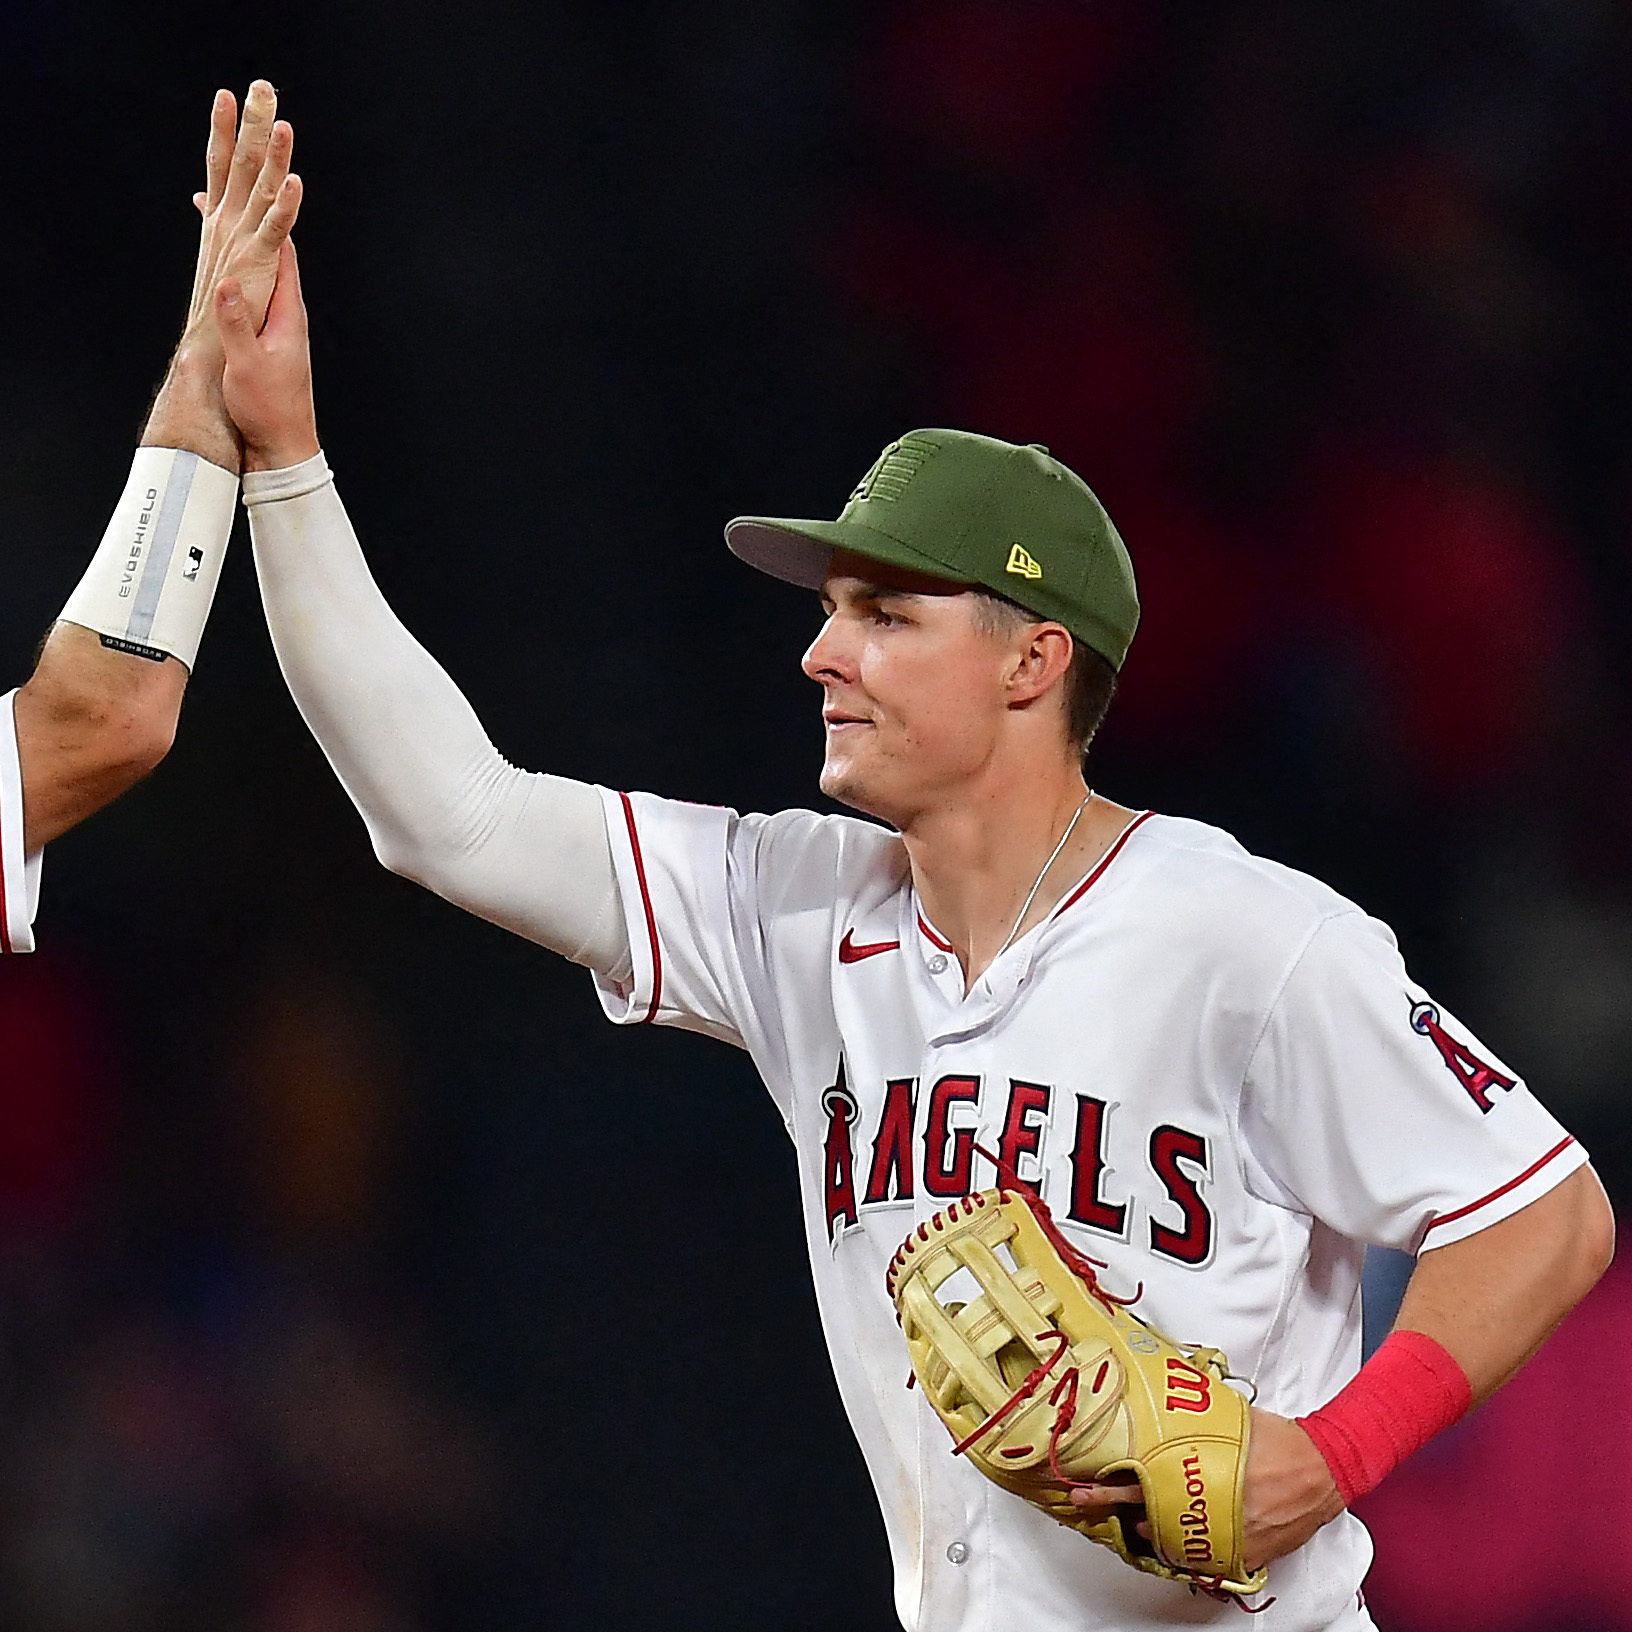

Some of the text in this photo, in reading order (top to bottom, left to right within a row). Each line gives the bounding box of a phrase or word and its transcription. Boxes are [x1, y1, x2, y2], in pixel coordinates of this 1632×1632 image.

[119, 487, 158, 598] EVOSHIELD
[1405, 992, 1519, 1114] A
[821, 1051, 1216, 1270] ANGELS
[1166, 1357, 1212, 1415] W
[1179, 1455, 1214, 1563] Wilson
